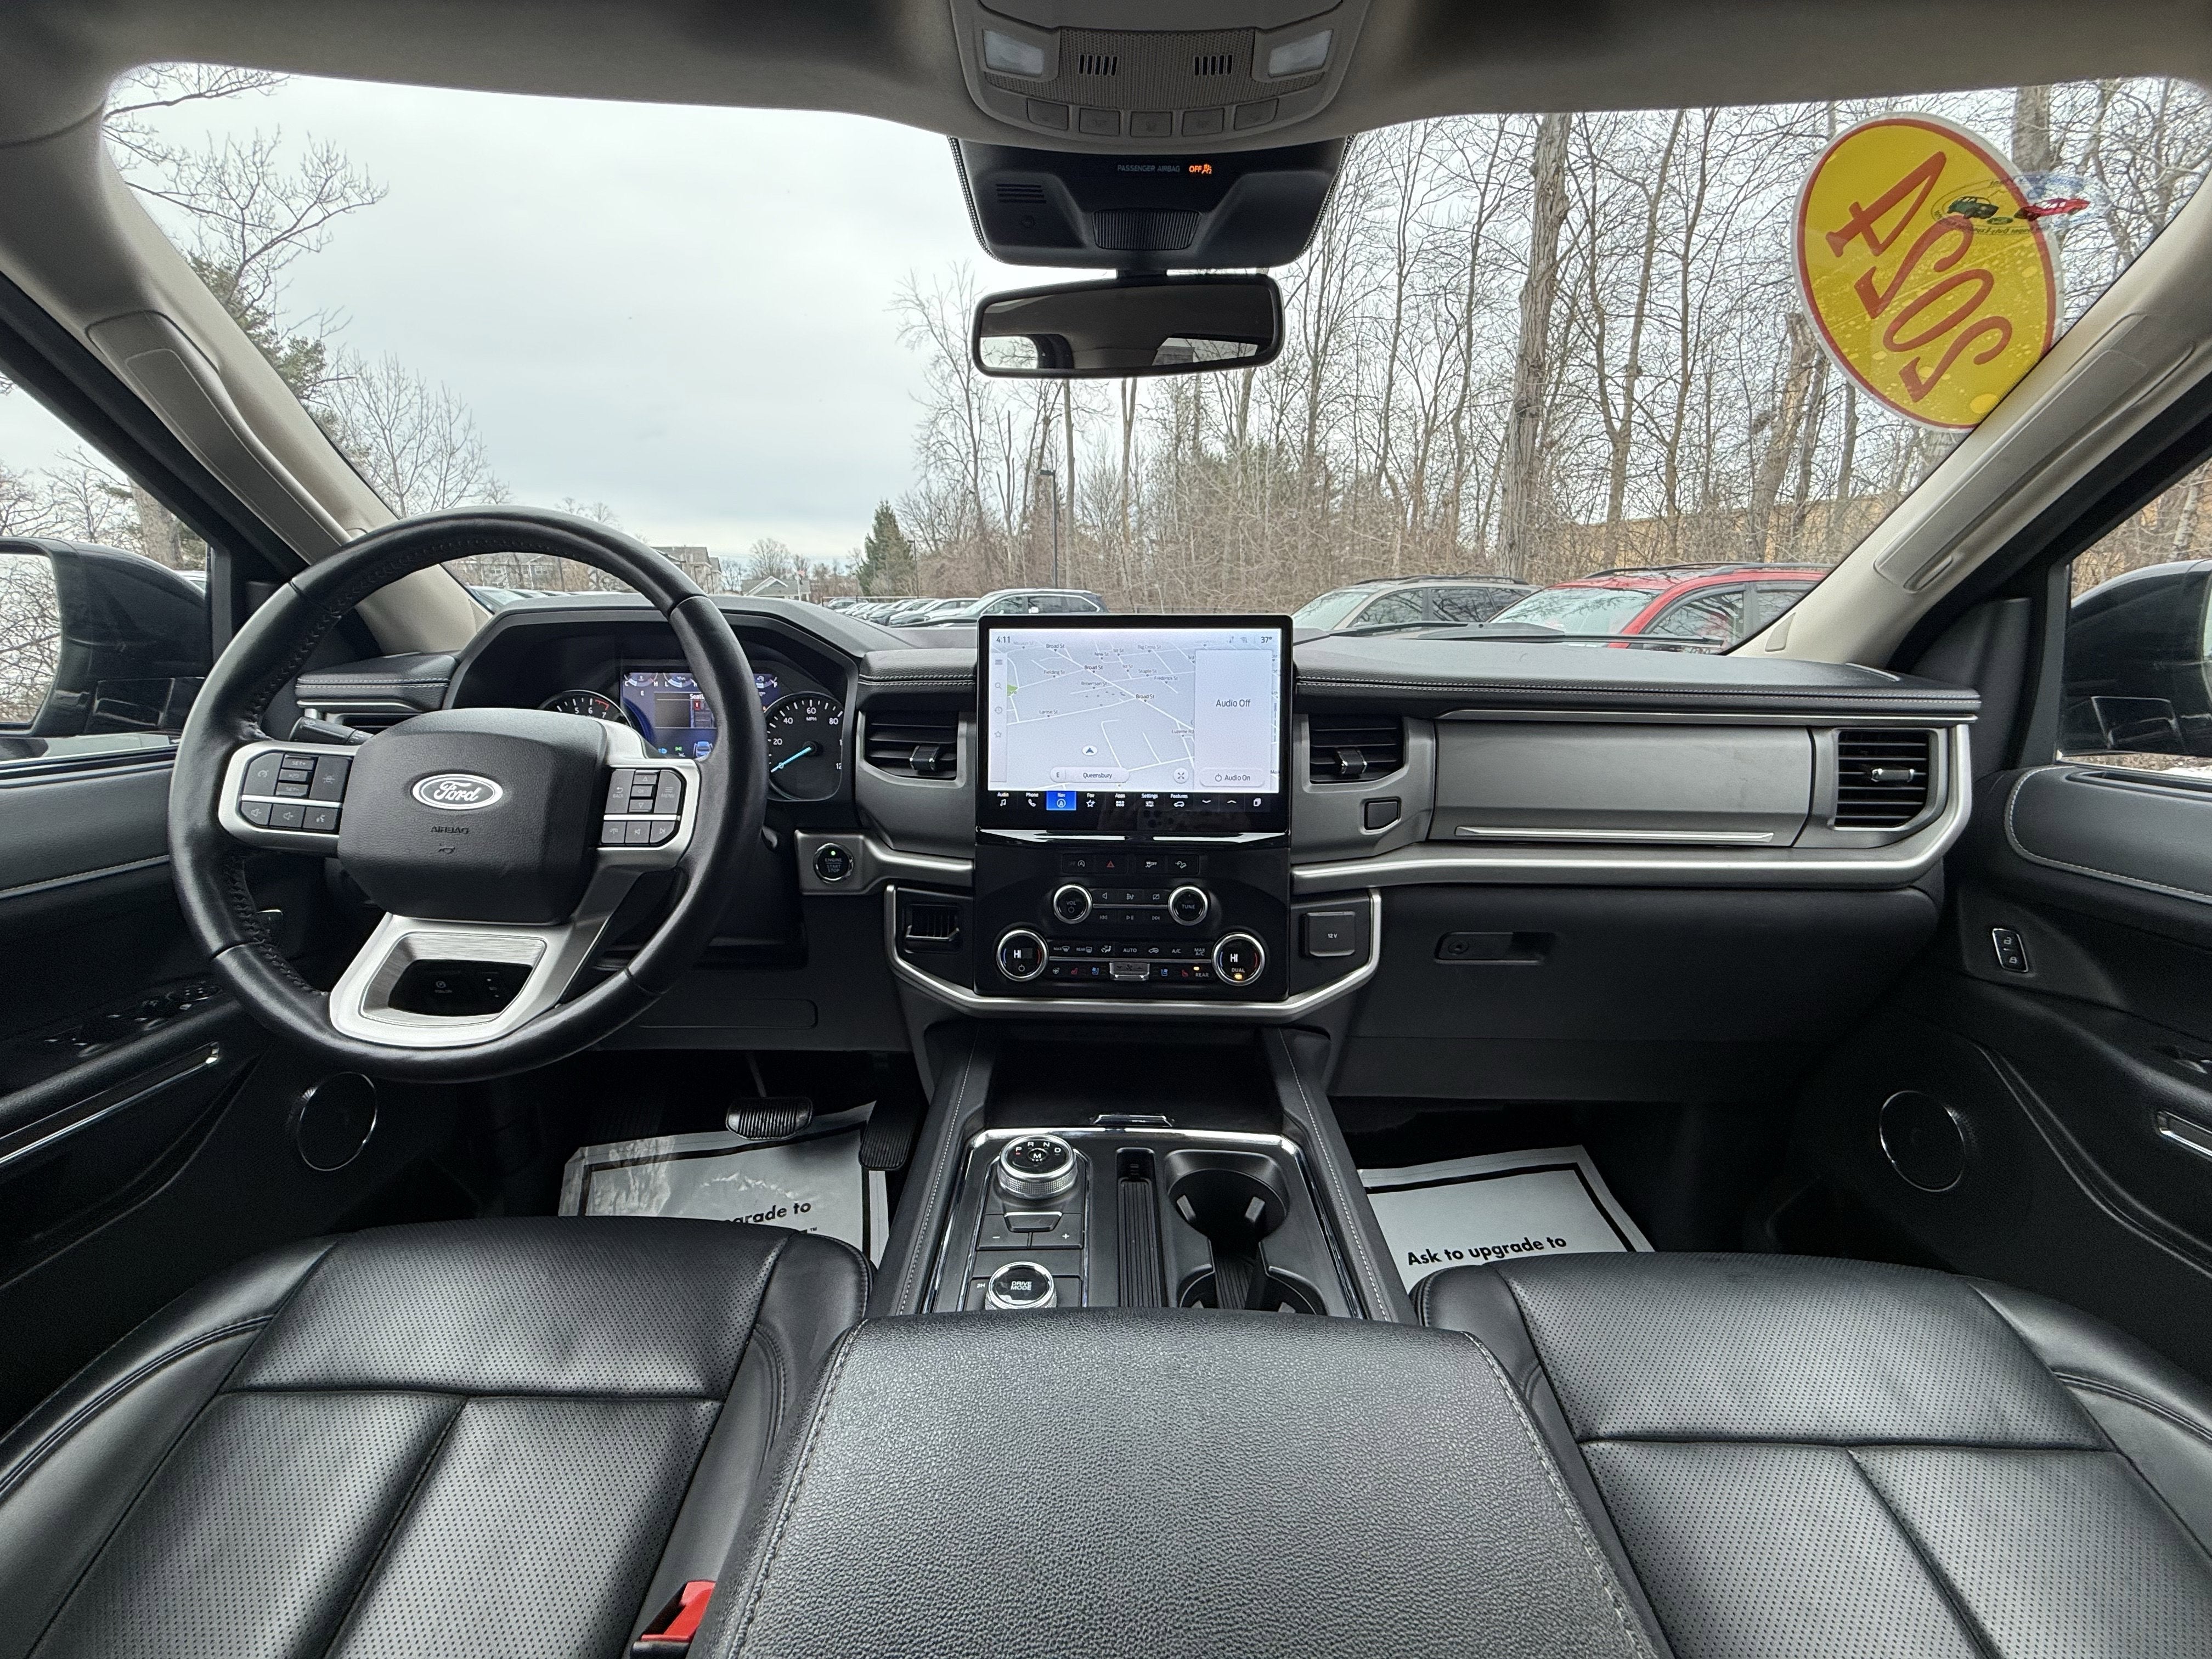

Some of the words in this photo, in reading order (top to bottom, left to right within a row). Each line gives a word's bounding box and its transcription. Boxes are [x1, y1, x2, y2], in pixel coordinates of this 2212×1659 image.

[433, 781, 482, 802] Ford
[430, 826, 469, 834] AIRBAG
[1014, 950, 1021, 958] HI
[1231, 953, 1238, 962] HI
[793, 1203, 811, 1214] to
[1408, 1249, 1442, 1266] Ask
[1444, 1249, 1464, 1261] to
[1468, 1237, 1544, 1261] upgrade
[1546, 1237, 1566, 1248] to
